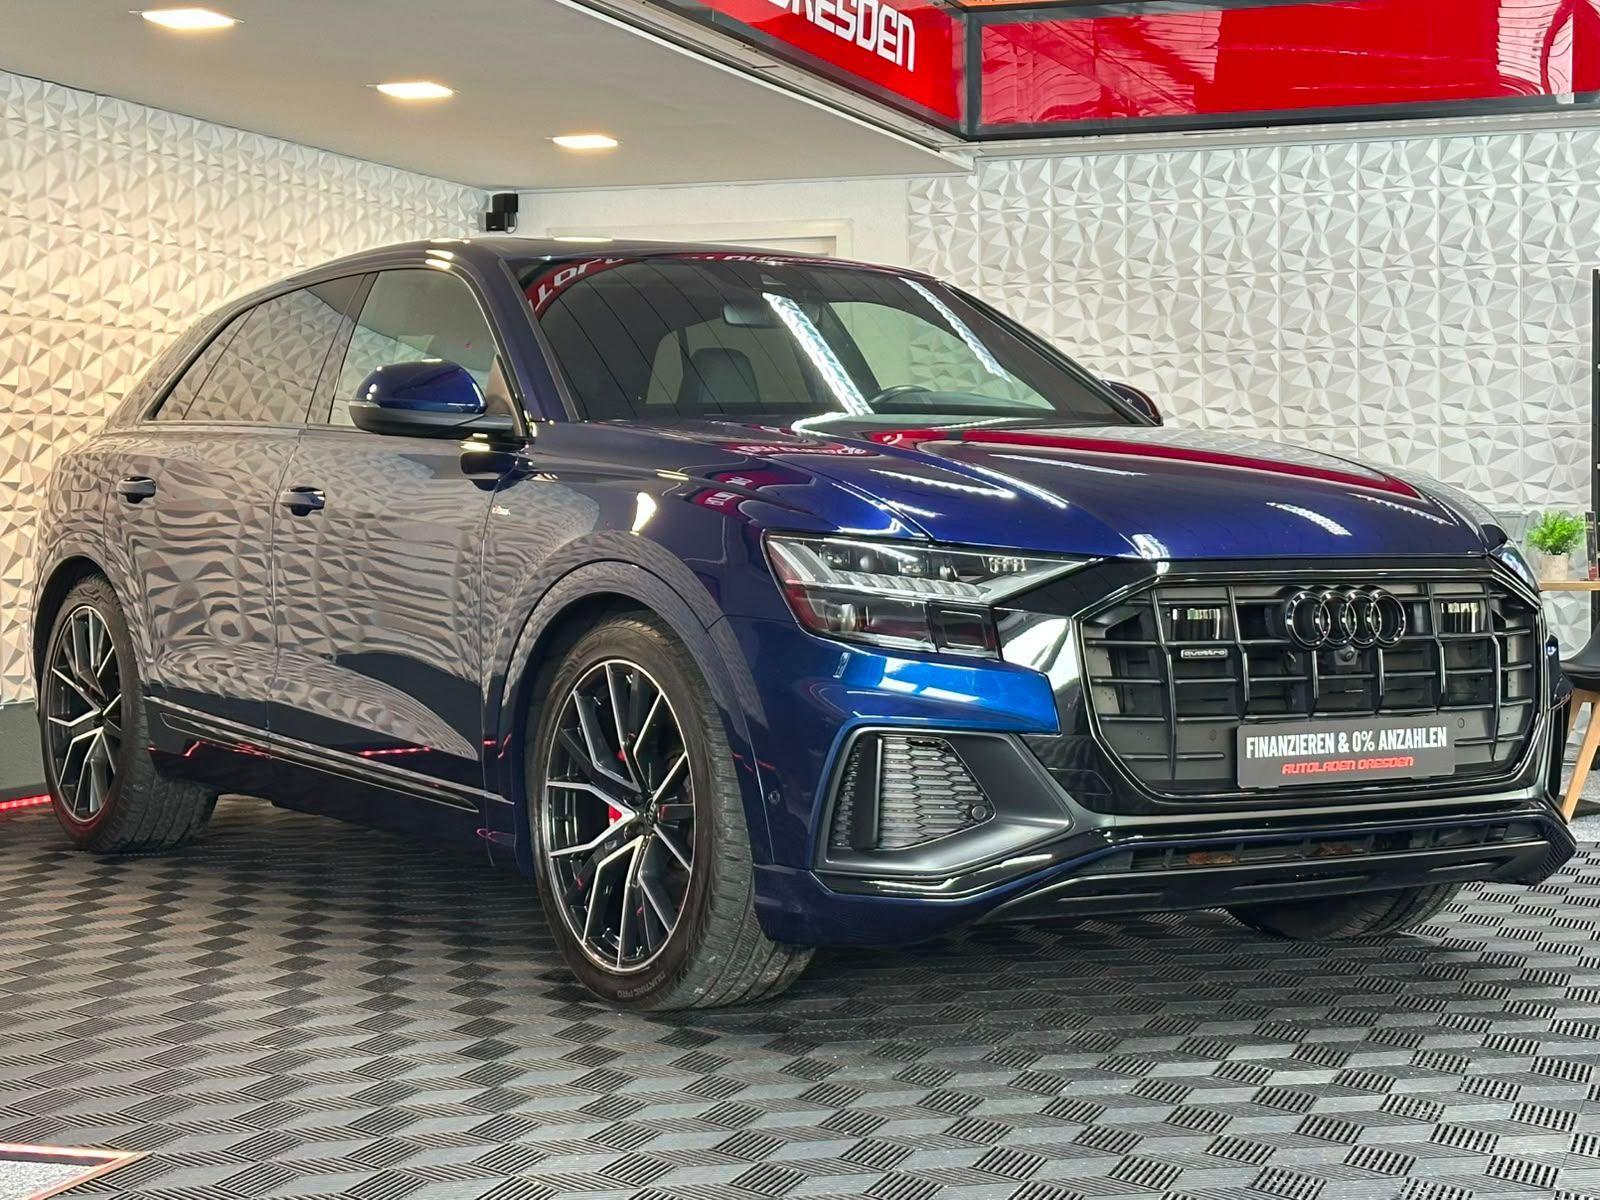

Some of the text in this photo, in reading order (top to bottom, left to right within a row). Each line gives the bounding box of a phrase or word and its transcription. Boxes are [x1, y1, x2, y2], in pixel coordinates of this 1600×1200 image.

[1184, 649, 1225, 657] quattro
[1246, 726, 1447, 758] FINANZIEREN & 0% ANZAHLEN
[1282, 756, 1414, 774] AUTOLADEN DRESDEN
